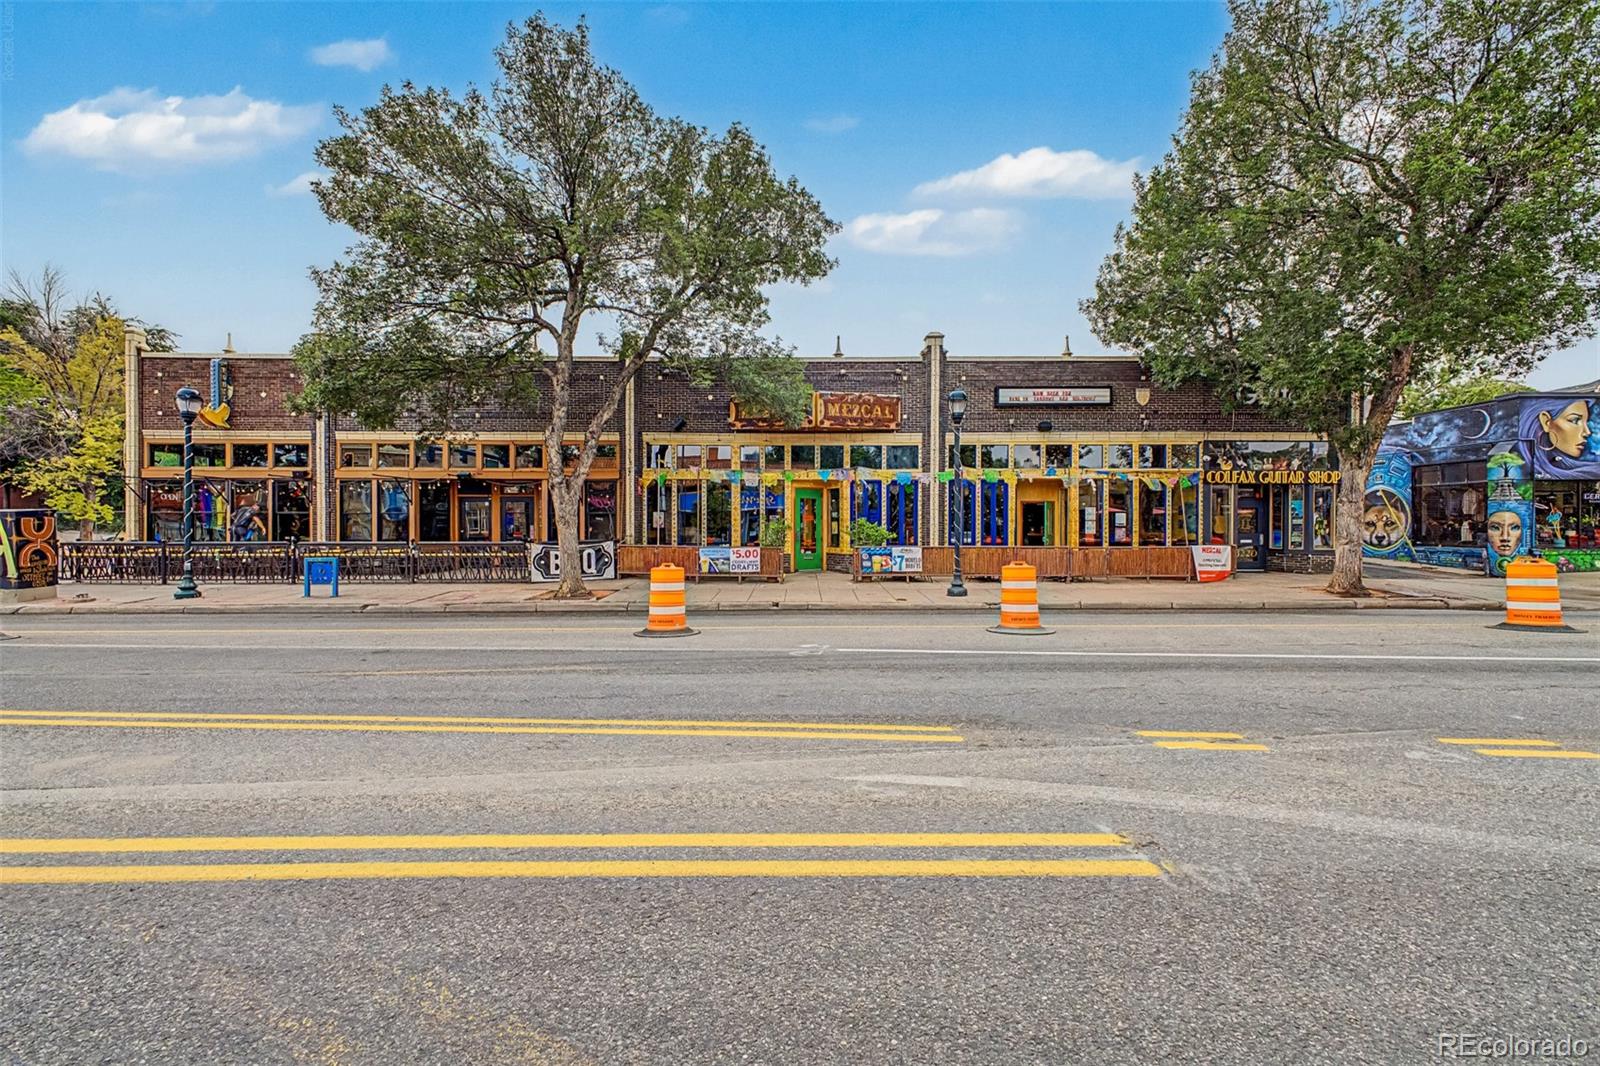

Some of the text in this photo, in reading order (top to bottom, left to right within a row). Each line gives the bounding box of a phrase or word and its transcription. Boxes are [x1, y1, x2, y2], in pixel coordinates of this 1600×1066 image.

[827, 402, 894, 418] MEZCAL
[1206, 470, 1342, 484] COLFAX GUITAR SHOP
[549, 548, 597, 575] BQ
